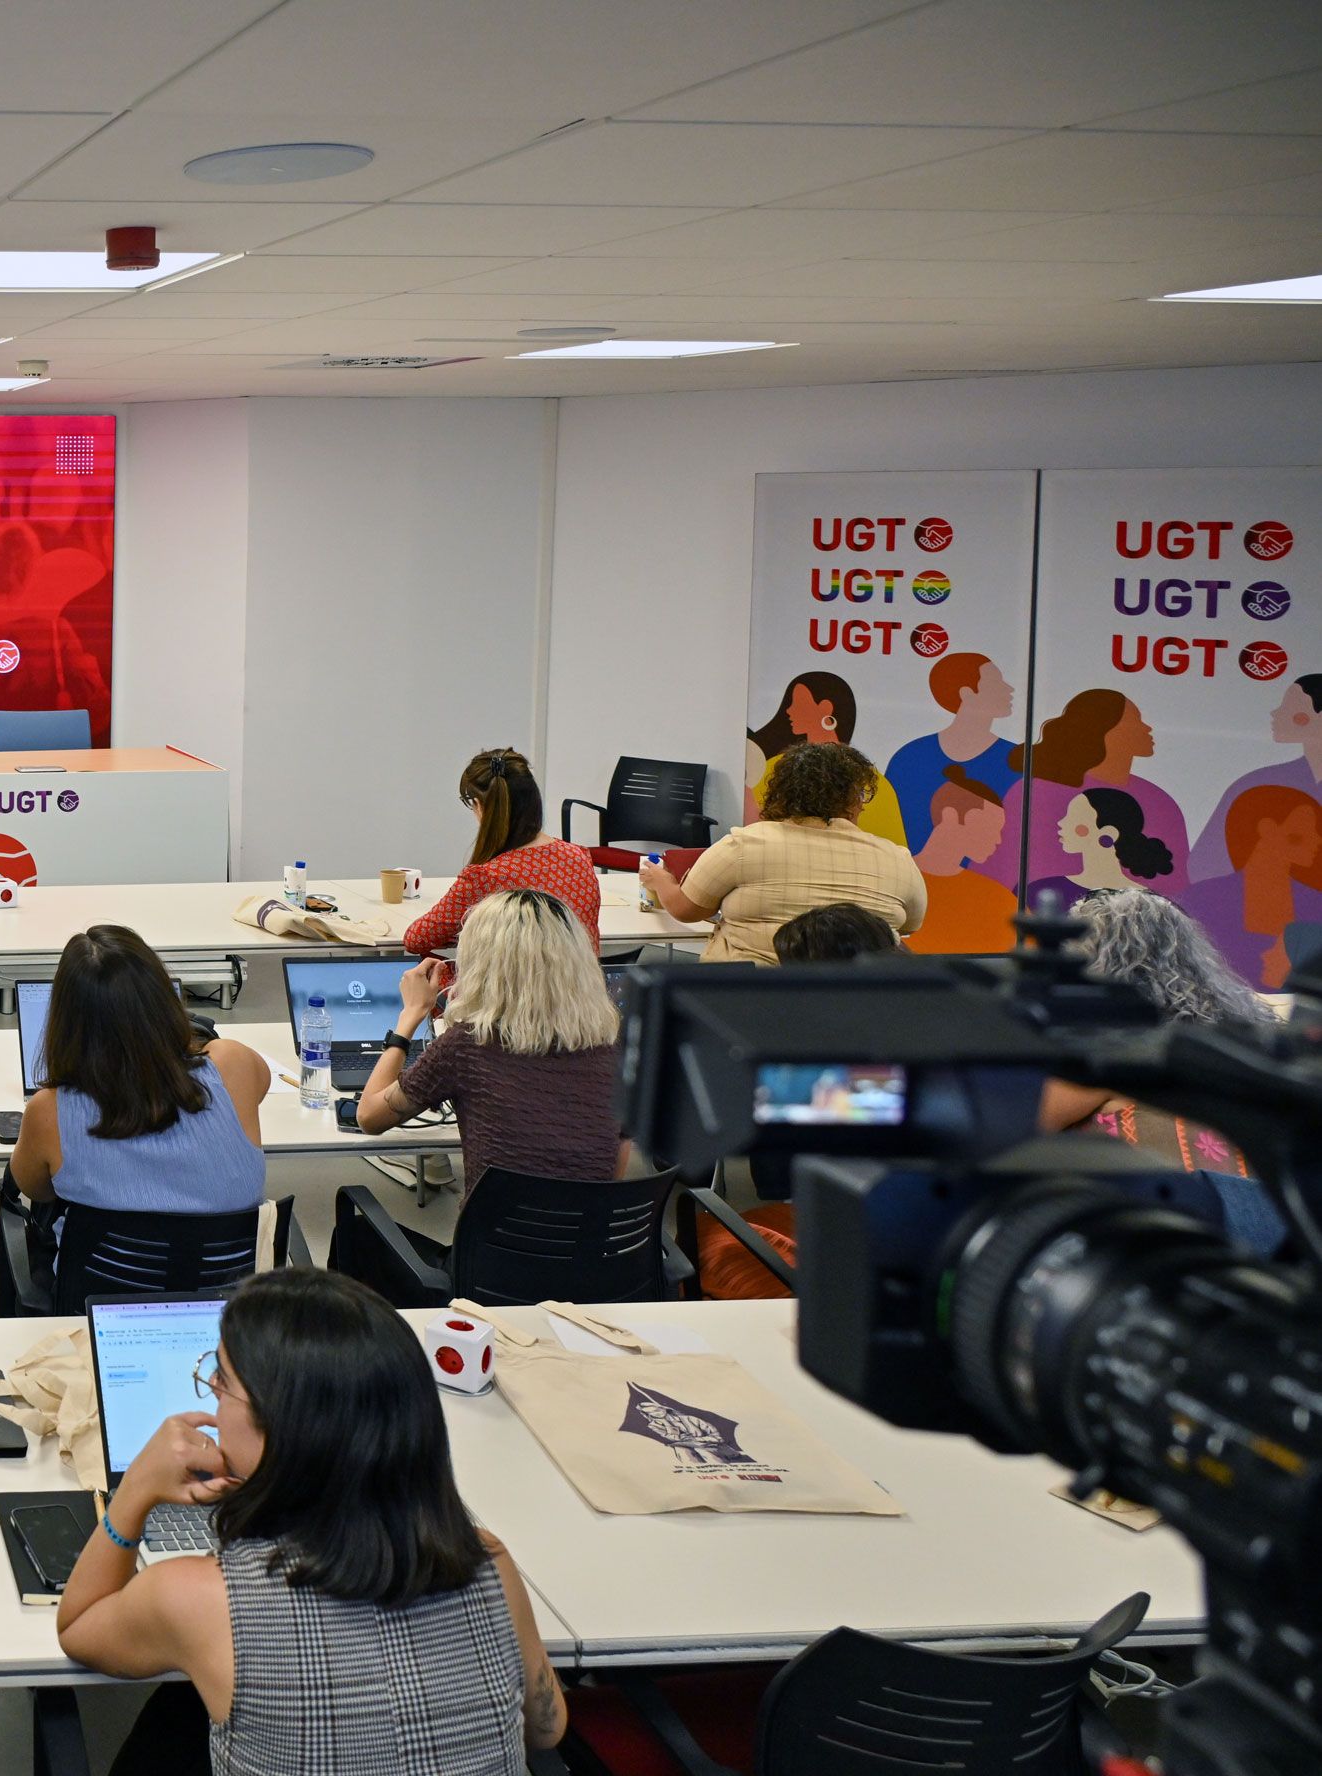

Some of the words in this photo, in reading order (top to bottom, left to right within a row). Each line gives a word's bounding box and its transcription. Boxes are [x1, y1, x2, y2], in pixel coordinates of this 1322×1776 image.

[812, 517, 906, 552] UGT
[1116, 520, 1234, 560] UGT
[811, 568, 904, 603] UGT
[1114, 577, 1231, 619] UGT
[809, 618, 902, 655] UGT
[1111, 634, 1229, 677] UGT
